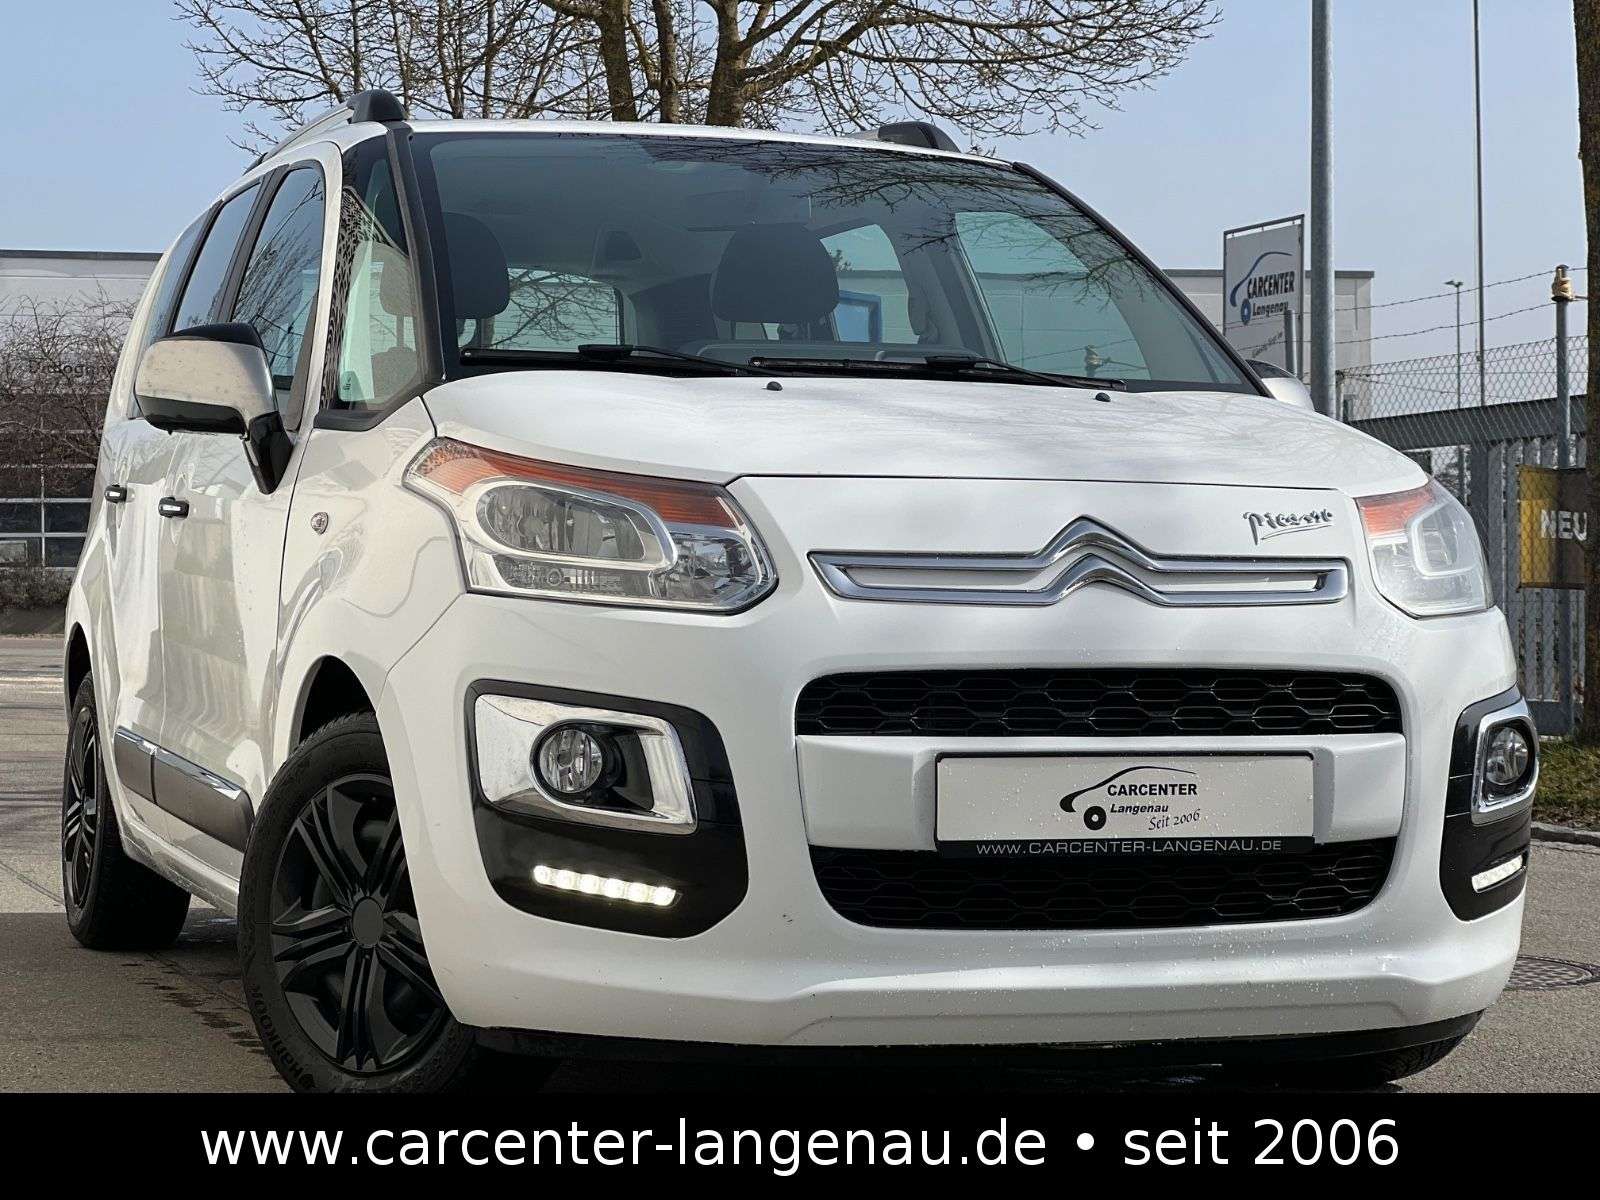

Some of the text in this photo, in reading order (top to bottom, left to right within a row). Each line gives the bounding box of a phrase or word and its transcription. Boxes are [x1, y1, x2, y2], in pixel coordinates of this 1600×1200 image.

[1247, 271, 1294, 299] CARCENTER
[1253, 301, 1288, 317] Langenau
[1541, 509, 1587, 541] NEU
[1107, 784, 1198, 796] CARCENTER
[1110, 804, 1169, 815] Langenau
[1148, 808, 1201, 831] Seit 2006
[976, 839, 1282, 855] WWW.CARCENTER-LANGENAU.DE
